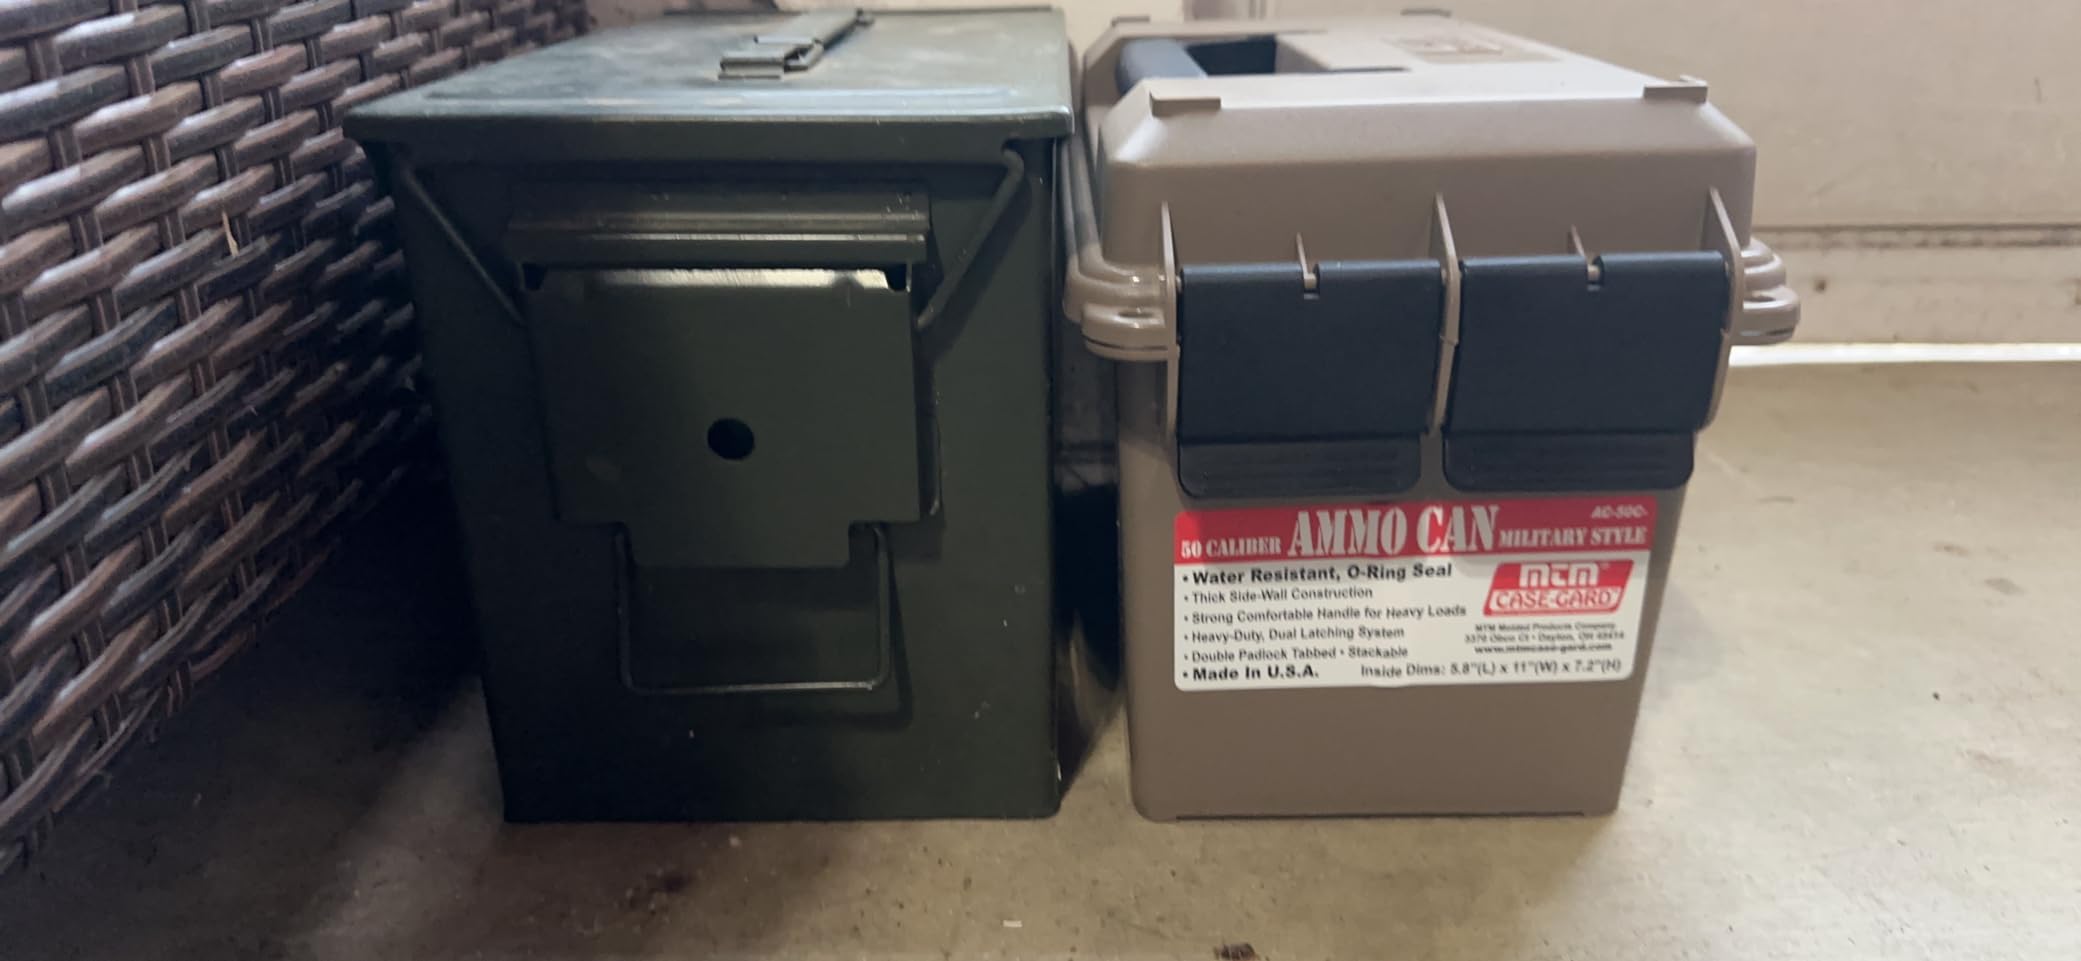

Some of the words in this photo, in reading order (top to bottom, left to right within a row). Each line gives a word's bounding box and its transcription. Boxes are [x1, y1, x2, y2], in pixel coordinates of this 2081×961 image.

[1287, 507, 1407, 556] AMMO
[1417, 505, 1499, 552] CAN
[1500, 528, 1586, 547] MILITARY
[1591, 526, 1647, 545] STYLE
[1181, 541, 1201, 558] 50
[1206, 537, 1281, 557] CALIBER
[1193, 571, 1244, 584] Water
[1252, 567, 1340, 582] Resistant,
[1348, 564, 1406, 581] O-Ring
[1413, 563, 1452, 577] Seal
[1193, 592, 1225, 603] Thick
[1230, 589, 1287, 602] Side-Wall
[1292, 587, 1373, 600] Construction
[1192, 611, 1233, 625] Strong
[1237, 608, 1313, 622] Comfortable
[1317, 607, 1360, 619] Handle
[1364, 607, 1381, 619] for
[1386, 606, 1423, 618] Heavy
[1428, 605, 1467, 617] Loads
[1192, 629, 1264, 644] Heavy-Duty,
[1269, 628, 1297, 640] Dual
[1301, 626, 1354, 640] Latching
[1358, 625, 1404, 639] System
[1192, 650, 1235, 663] Double
[1239, 649, 1287, 661] Padlock
[1293, 647, 1336, 659] Tabbed
[1348, 645, 1408, 658] Stackable
[1193, 667, 1239, 681] Made
[1245, 666, 1261, 680] In
[1267, 664, 1319, 679] U.S.A.
[1361, 664, 1402, 677] Inside
[1406, 663, 1446, 676] Dims:
[1501, 664, 1507, 673] x
[1562, 662, 1569, 672] x
